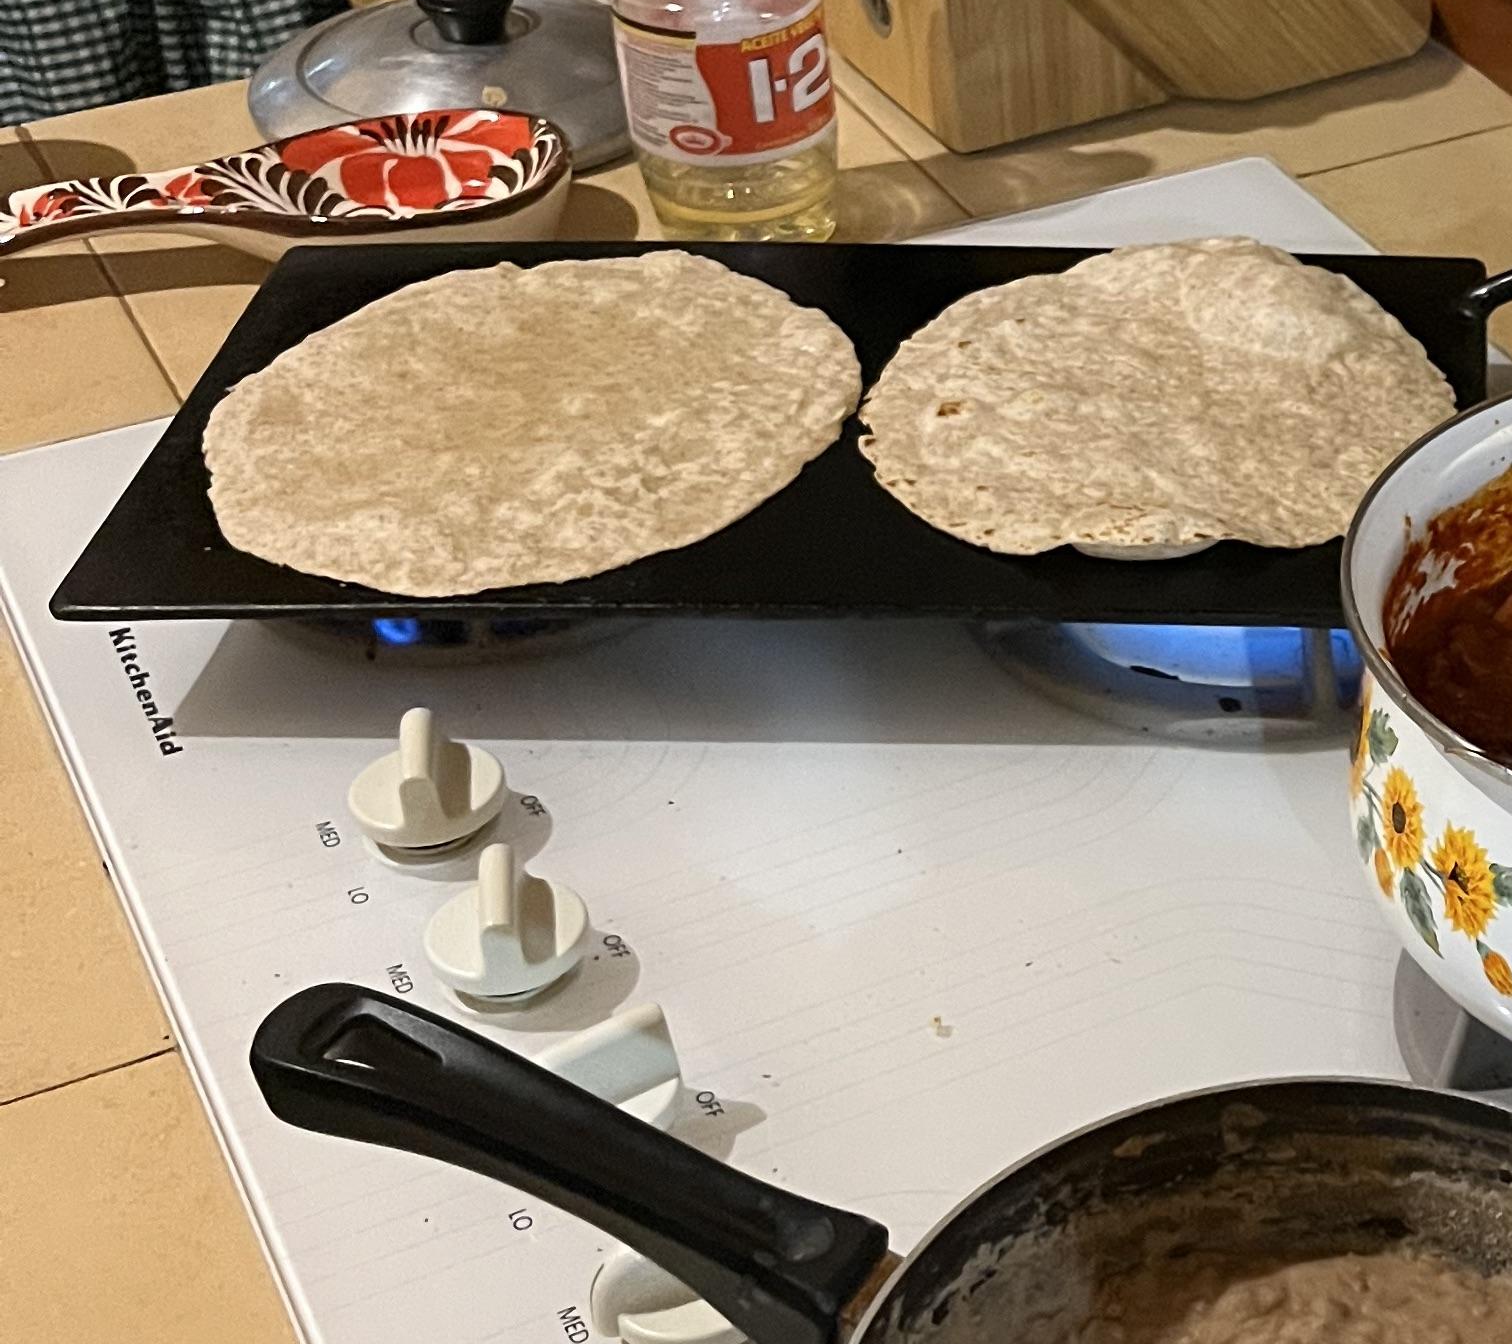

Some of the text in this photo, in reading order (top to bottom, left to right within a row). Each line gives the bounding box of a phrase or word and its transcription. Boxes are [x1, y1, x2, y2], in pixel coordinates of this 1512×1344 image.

[109, 627, 183, 756] KitchenAid
[520, 795, 546, 816] OFF
[315, 821, 341, 847] MED
[347, 886, 369, 904] LO
[603, 934, 631, 957] OFF
[386, 963, 413, 994] MED
[696, 1091, 724, 1116] OFF
[508, 1208, 533, 1231] LO
[557, 1306, 589, 1344] MED
